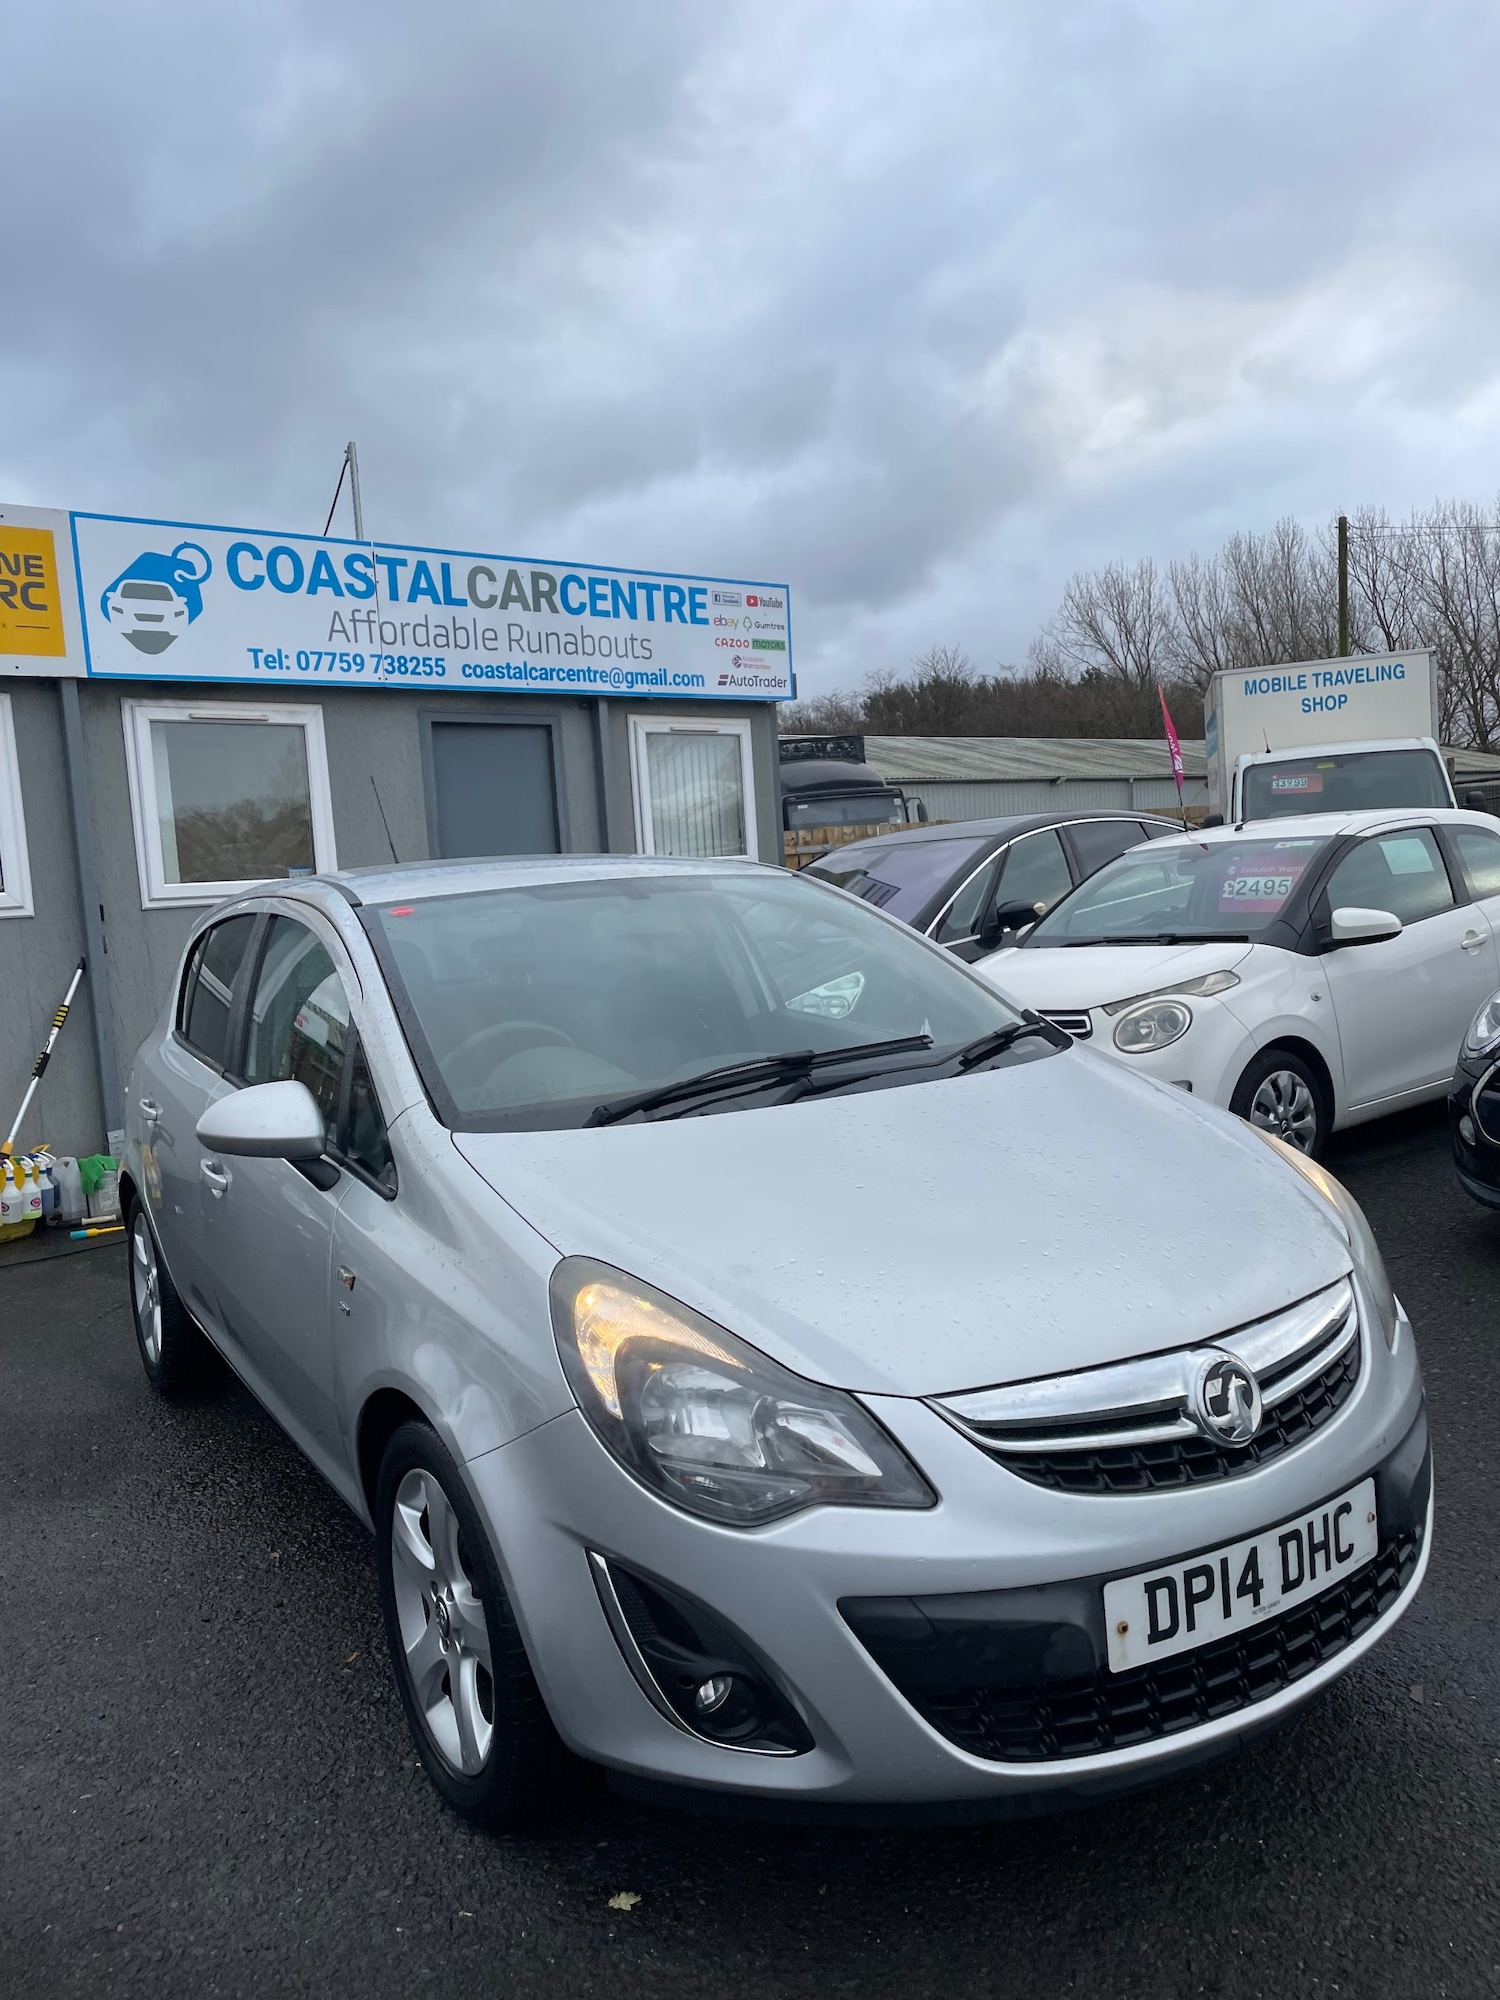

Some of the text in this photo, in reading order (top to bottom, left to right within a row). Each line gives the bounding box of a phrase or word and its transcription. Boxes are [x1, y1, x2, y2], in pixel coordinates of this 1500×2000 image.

[759, 597, 783, 609] YouTube
[713, 614, 739, 630] ebay
[754, 621, 785, 631] Gumtree
[328, 609, 653, 660] Affordable Runabouts
[714, 637, 750, 649] CAZOO
[247, 648, 705, 689] Tel: 07759 738255 coastalcarcentre@gmail.com
[729, 674, 788, 688] AutoTrader
[1244, 663, 1405, 695] MOBILE TRAVELING
[1301, 694, 1348, 713] SHOP
[1222, 879, 1290, 898] £2495
[1144, 1501, 1355, 1645] DP14 DHC
